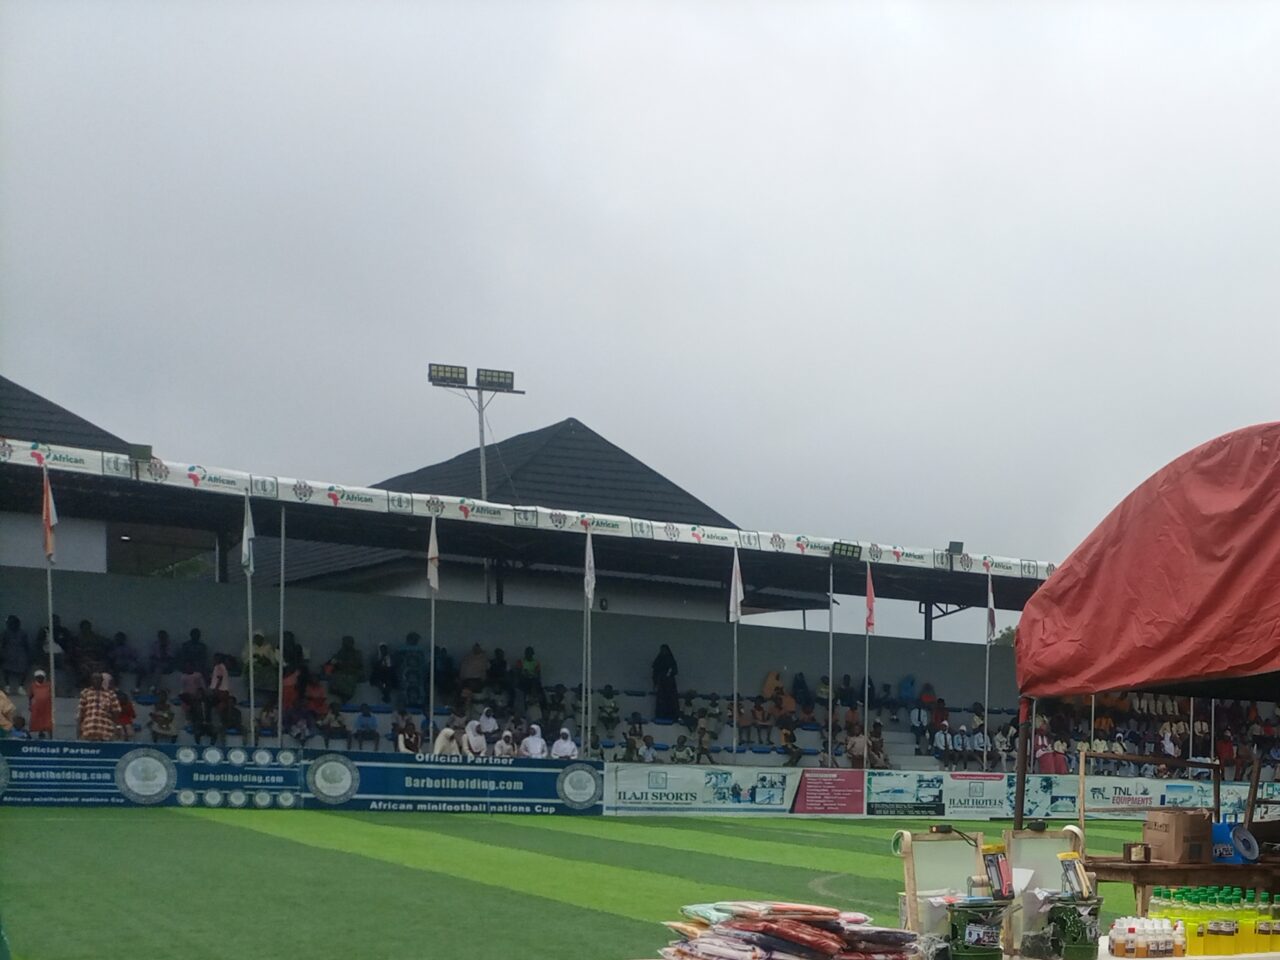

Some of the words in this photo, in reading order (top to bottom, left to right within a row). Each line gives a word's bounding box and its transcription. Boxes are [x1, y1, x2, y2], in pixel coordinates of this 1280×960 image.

[51, 453, 85, 465] African
[207, 475, 236, 486] African
[345, 493, 373, 503] African
[475, 506, 502, 516] African
[595, 519, 619, 529] African
[21, 745, 60, 755] Official
[63, 746, 101, 756] Partner
[415, 753, 463, 763] Official
[467, 755, 515, 766] Partner
[404, 776, 524, 791] Barbotiholding.com
[1112, 786, 1132, 796] TNL
[651, 792, 697, 802] SPORTS
[1112, 796, 1153, 806] EQUIPMENTS
[369, 800, 414, 810] African
[417, 801, 486, 812] minifootball
[490, 803, 530, 813] nations
[534, 804, 556, 815] Cup
